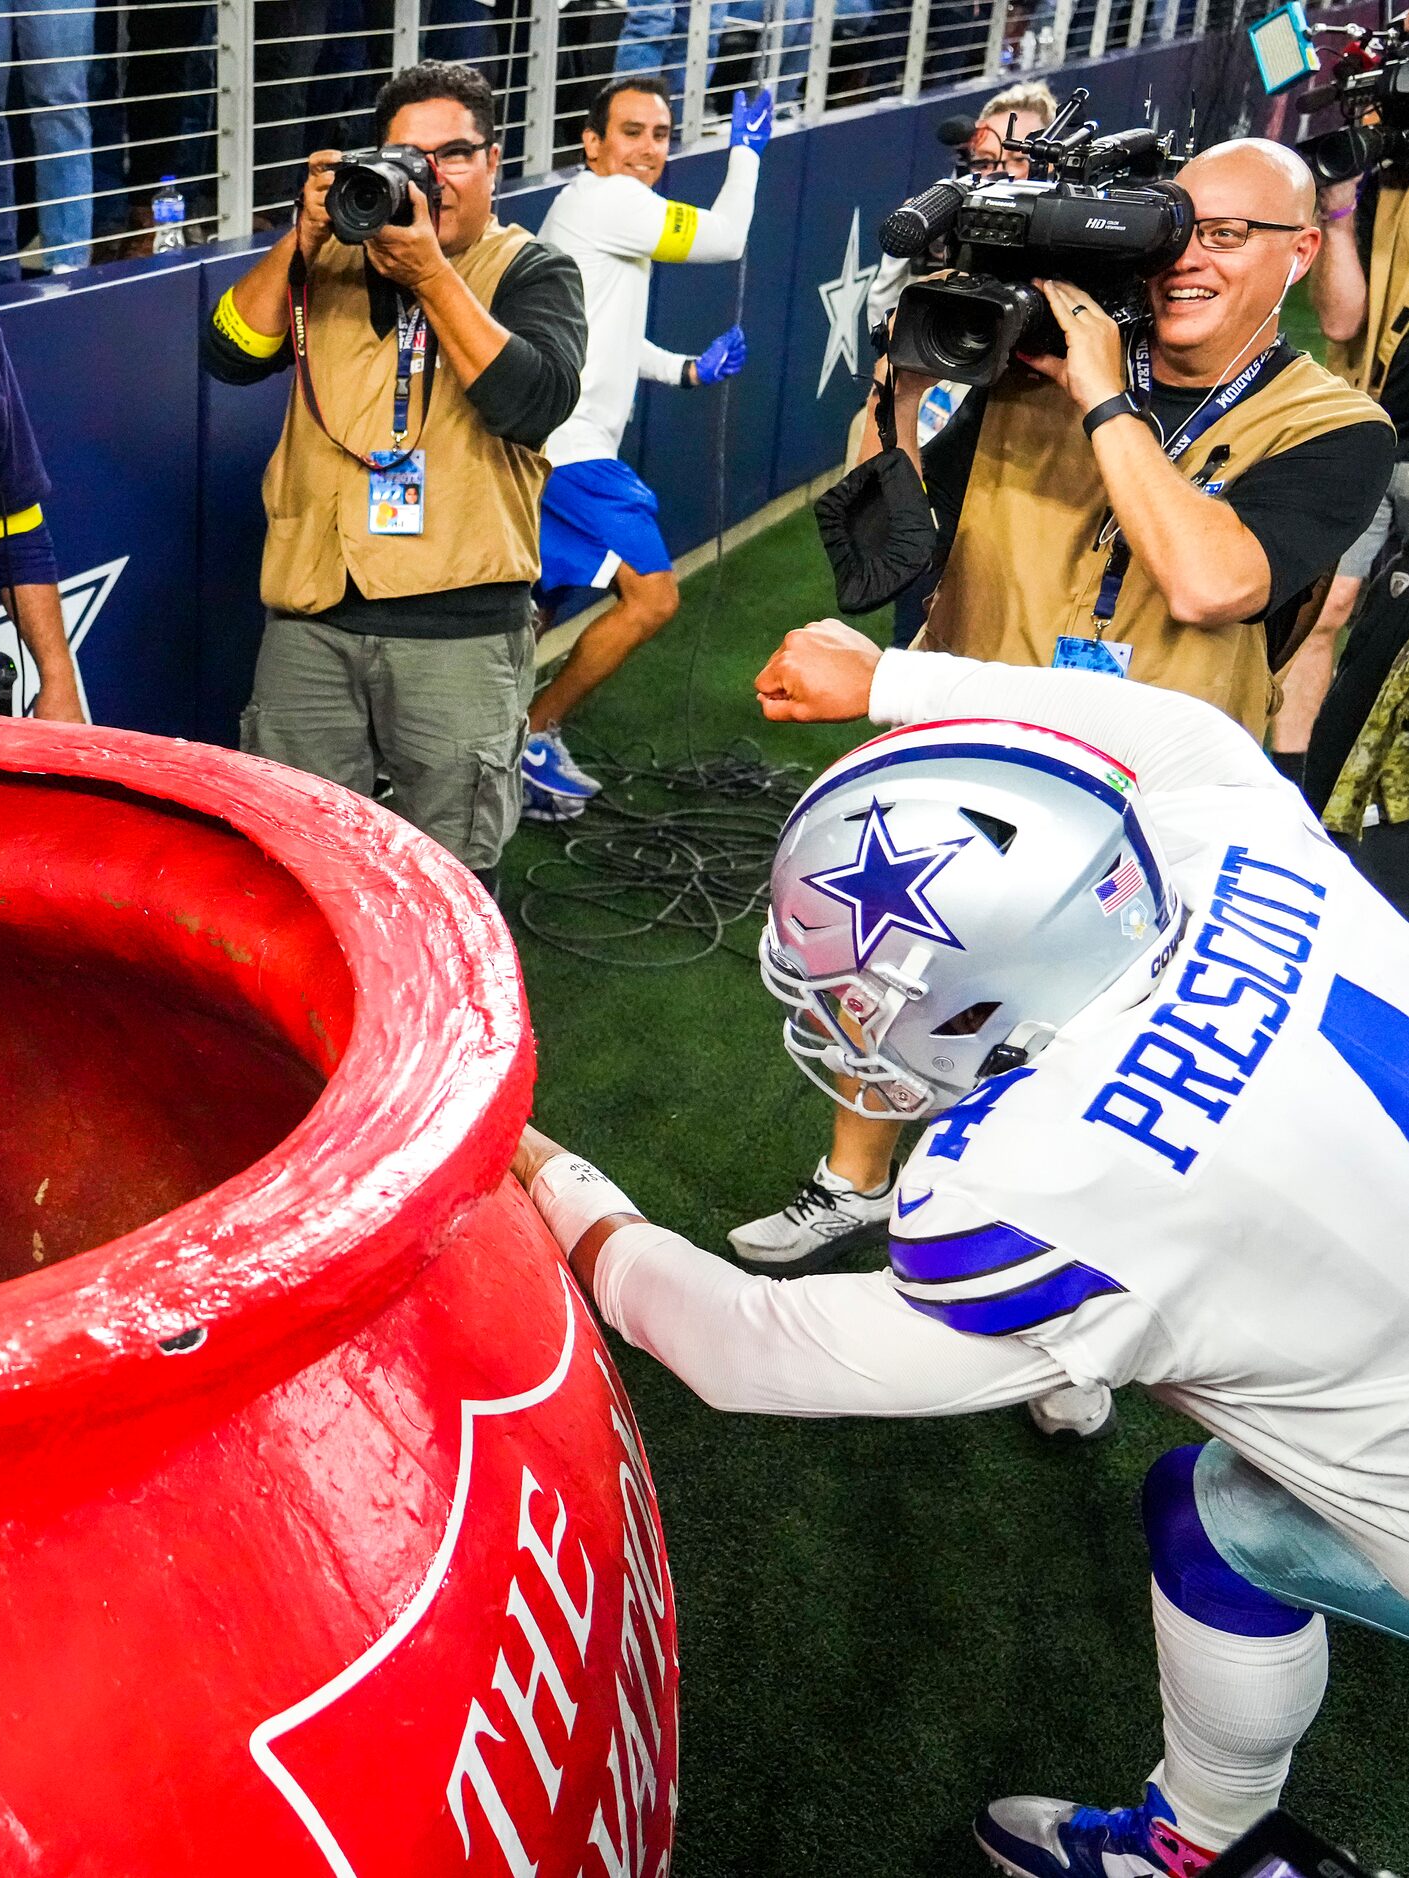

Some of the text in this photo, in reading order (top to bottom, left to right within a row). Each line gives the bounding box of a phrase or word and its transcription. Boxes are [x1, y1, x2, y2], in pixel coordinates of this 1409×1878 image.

[1085, 218, 1107, 231] HD
[295, 306, 305, 356] Canon
[1137, 361, 1151, 392] AT&T
[1215, 361, 1261, 409] STADIUM
[1081, 845, 1327, 1176] PRESCOTT
[926, 1066, 1039, 1162] 4
[446, 1464, 595, 1878] THE
